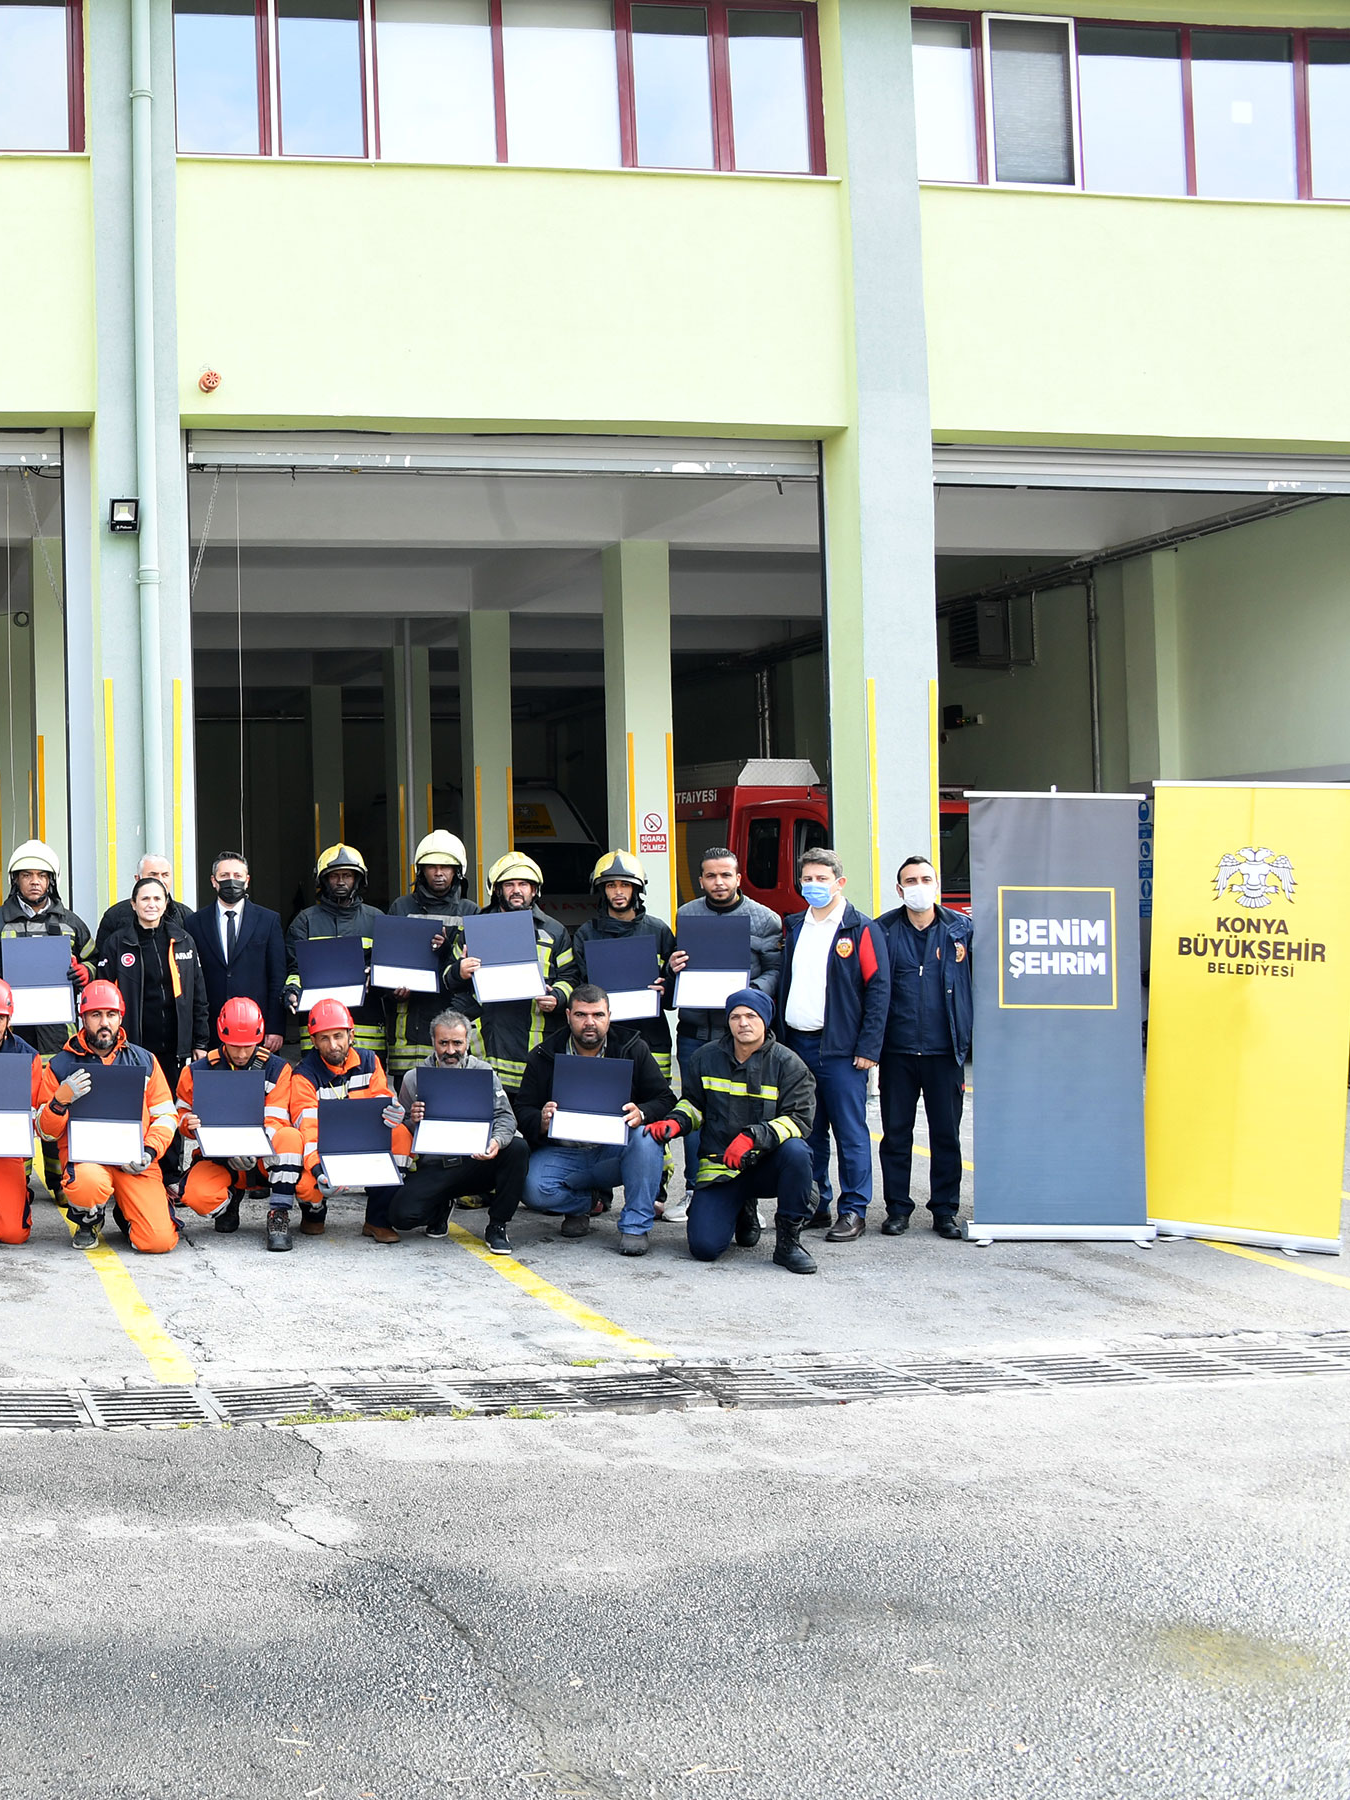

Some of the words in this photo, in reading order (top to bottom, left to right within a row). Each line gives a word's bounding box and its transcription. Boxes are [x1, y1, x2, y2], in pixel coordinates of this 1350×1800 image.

[675, 789, 718, 804] TFAİYESİ
[641, 835, 666, 843] SİGARA
[641, 843, 666, 852] İÇİLMEZ
[1008, 918, 1106, 947] BENİM
[1216, 916, 1289, 935] KONYA
[1178, 936, 1326, 964] BÜYÜKŞEHİR
[1008, 951, 1106, 979] ŞEHRİM
[1207, 960, 1295, 978] BELEDİYESİ
